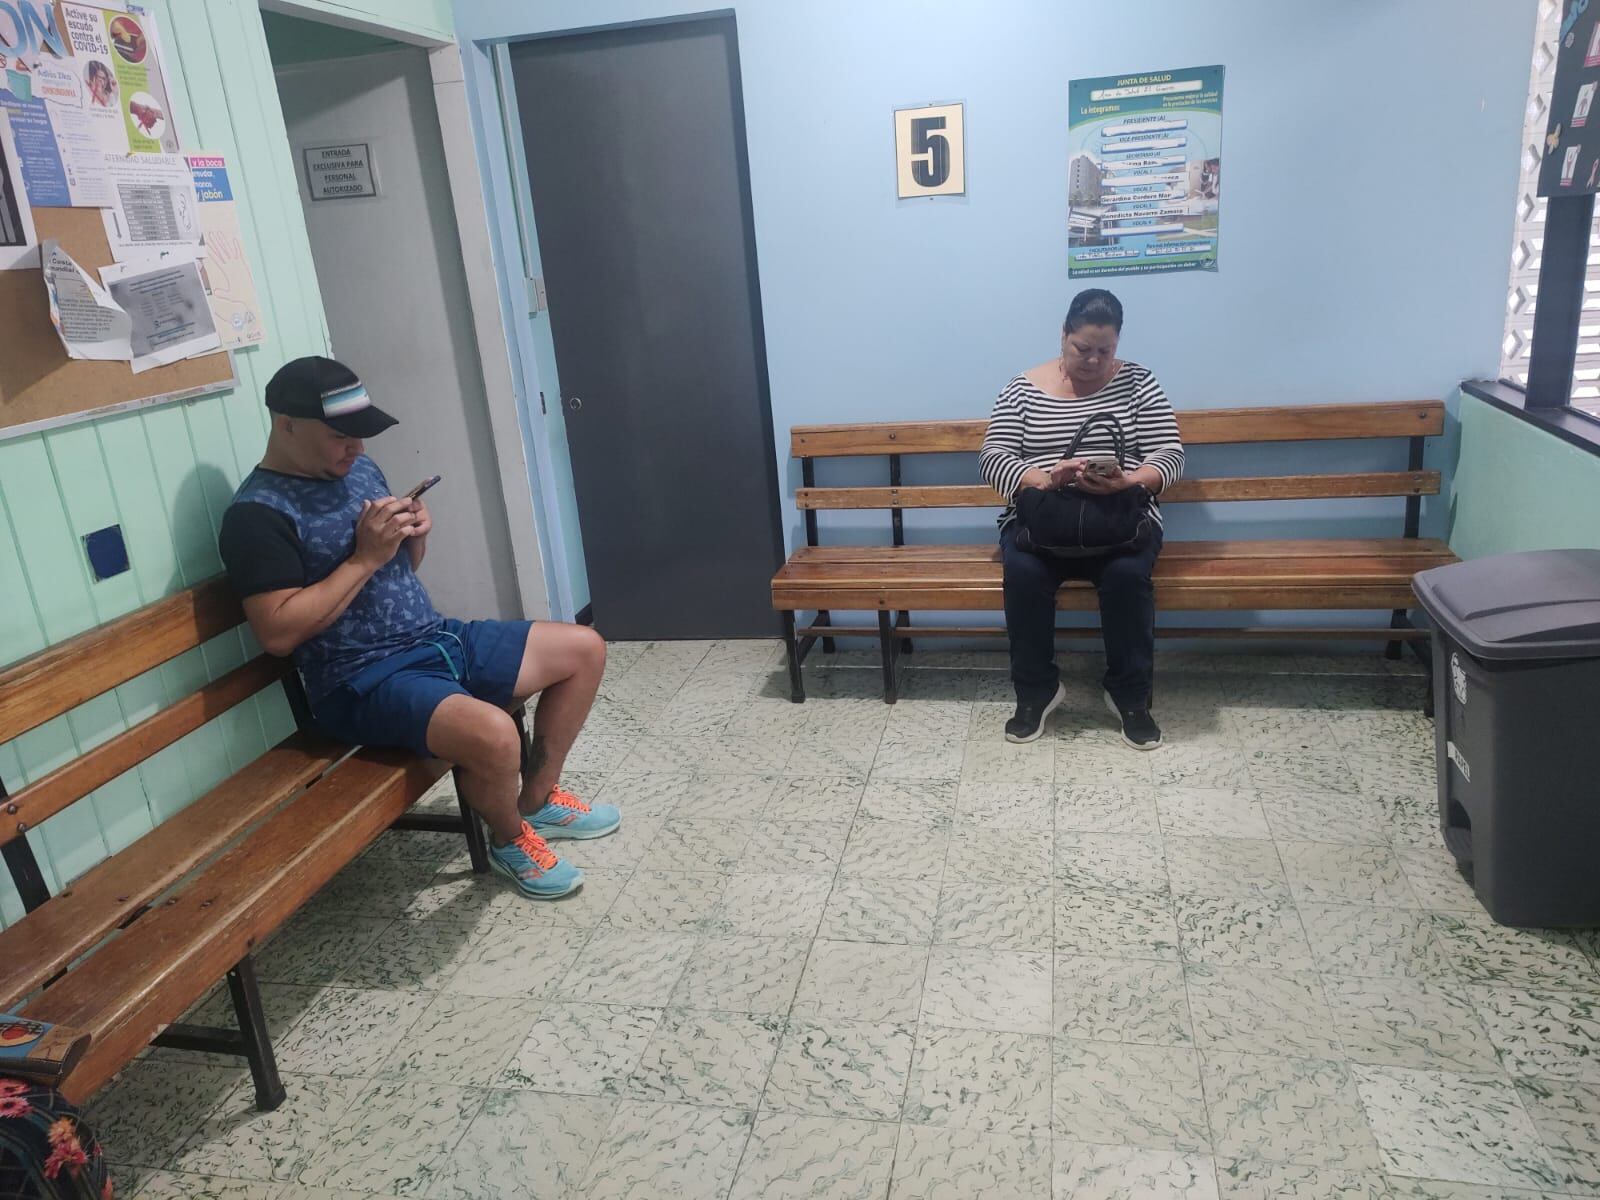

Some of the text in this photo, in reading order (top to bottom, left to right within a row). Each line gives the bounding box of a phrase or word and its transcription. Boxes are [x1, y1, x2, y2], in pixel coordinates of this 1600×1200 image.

[65, 8, 98, 22] Active su
[68, 20, 94, 32] escudo
[71, 31, 102, 43] contra el
[1117, 79, 1139, 87] JUNTA
[1149, 74, 1172, 82] SALUD
[1089, 105, 1120, 114] integramos
[1123, 116, 1156, 124] PRESIDENTE
[321, 148, 352, 159] ENTRADA
[910, 115, 951, 188] 5
[313, 159, 364, 171] EXCLUSIVA PARA
[324, 172, 356, 181] PERSONAL
[323, 184, 363, 194] AUTORIZADO
